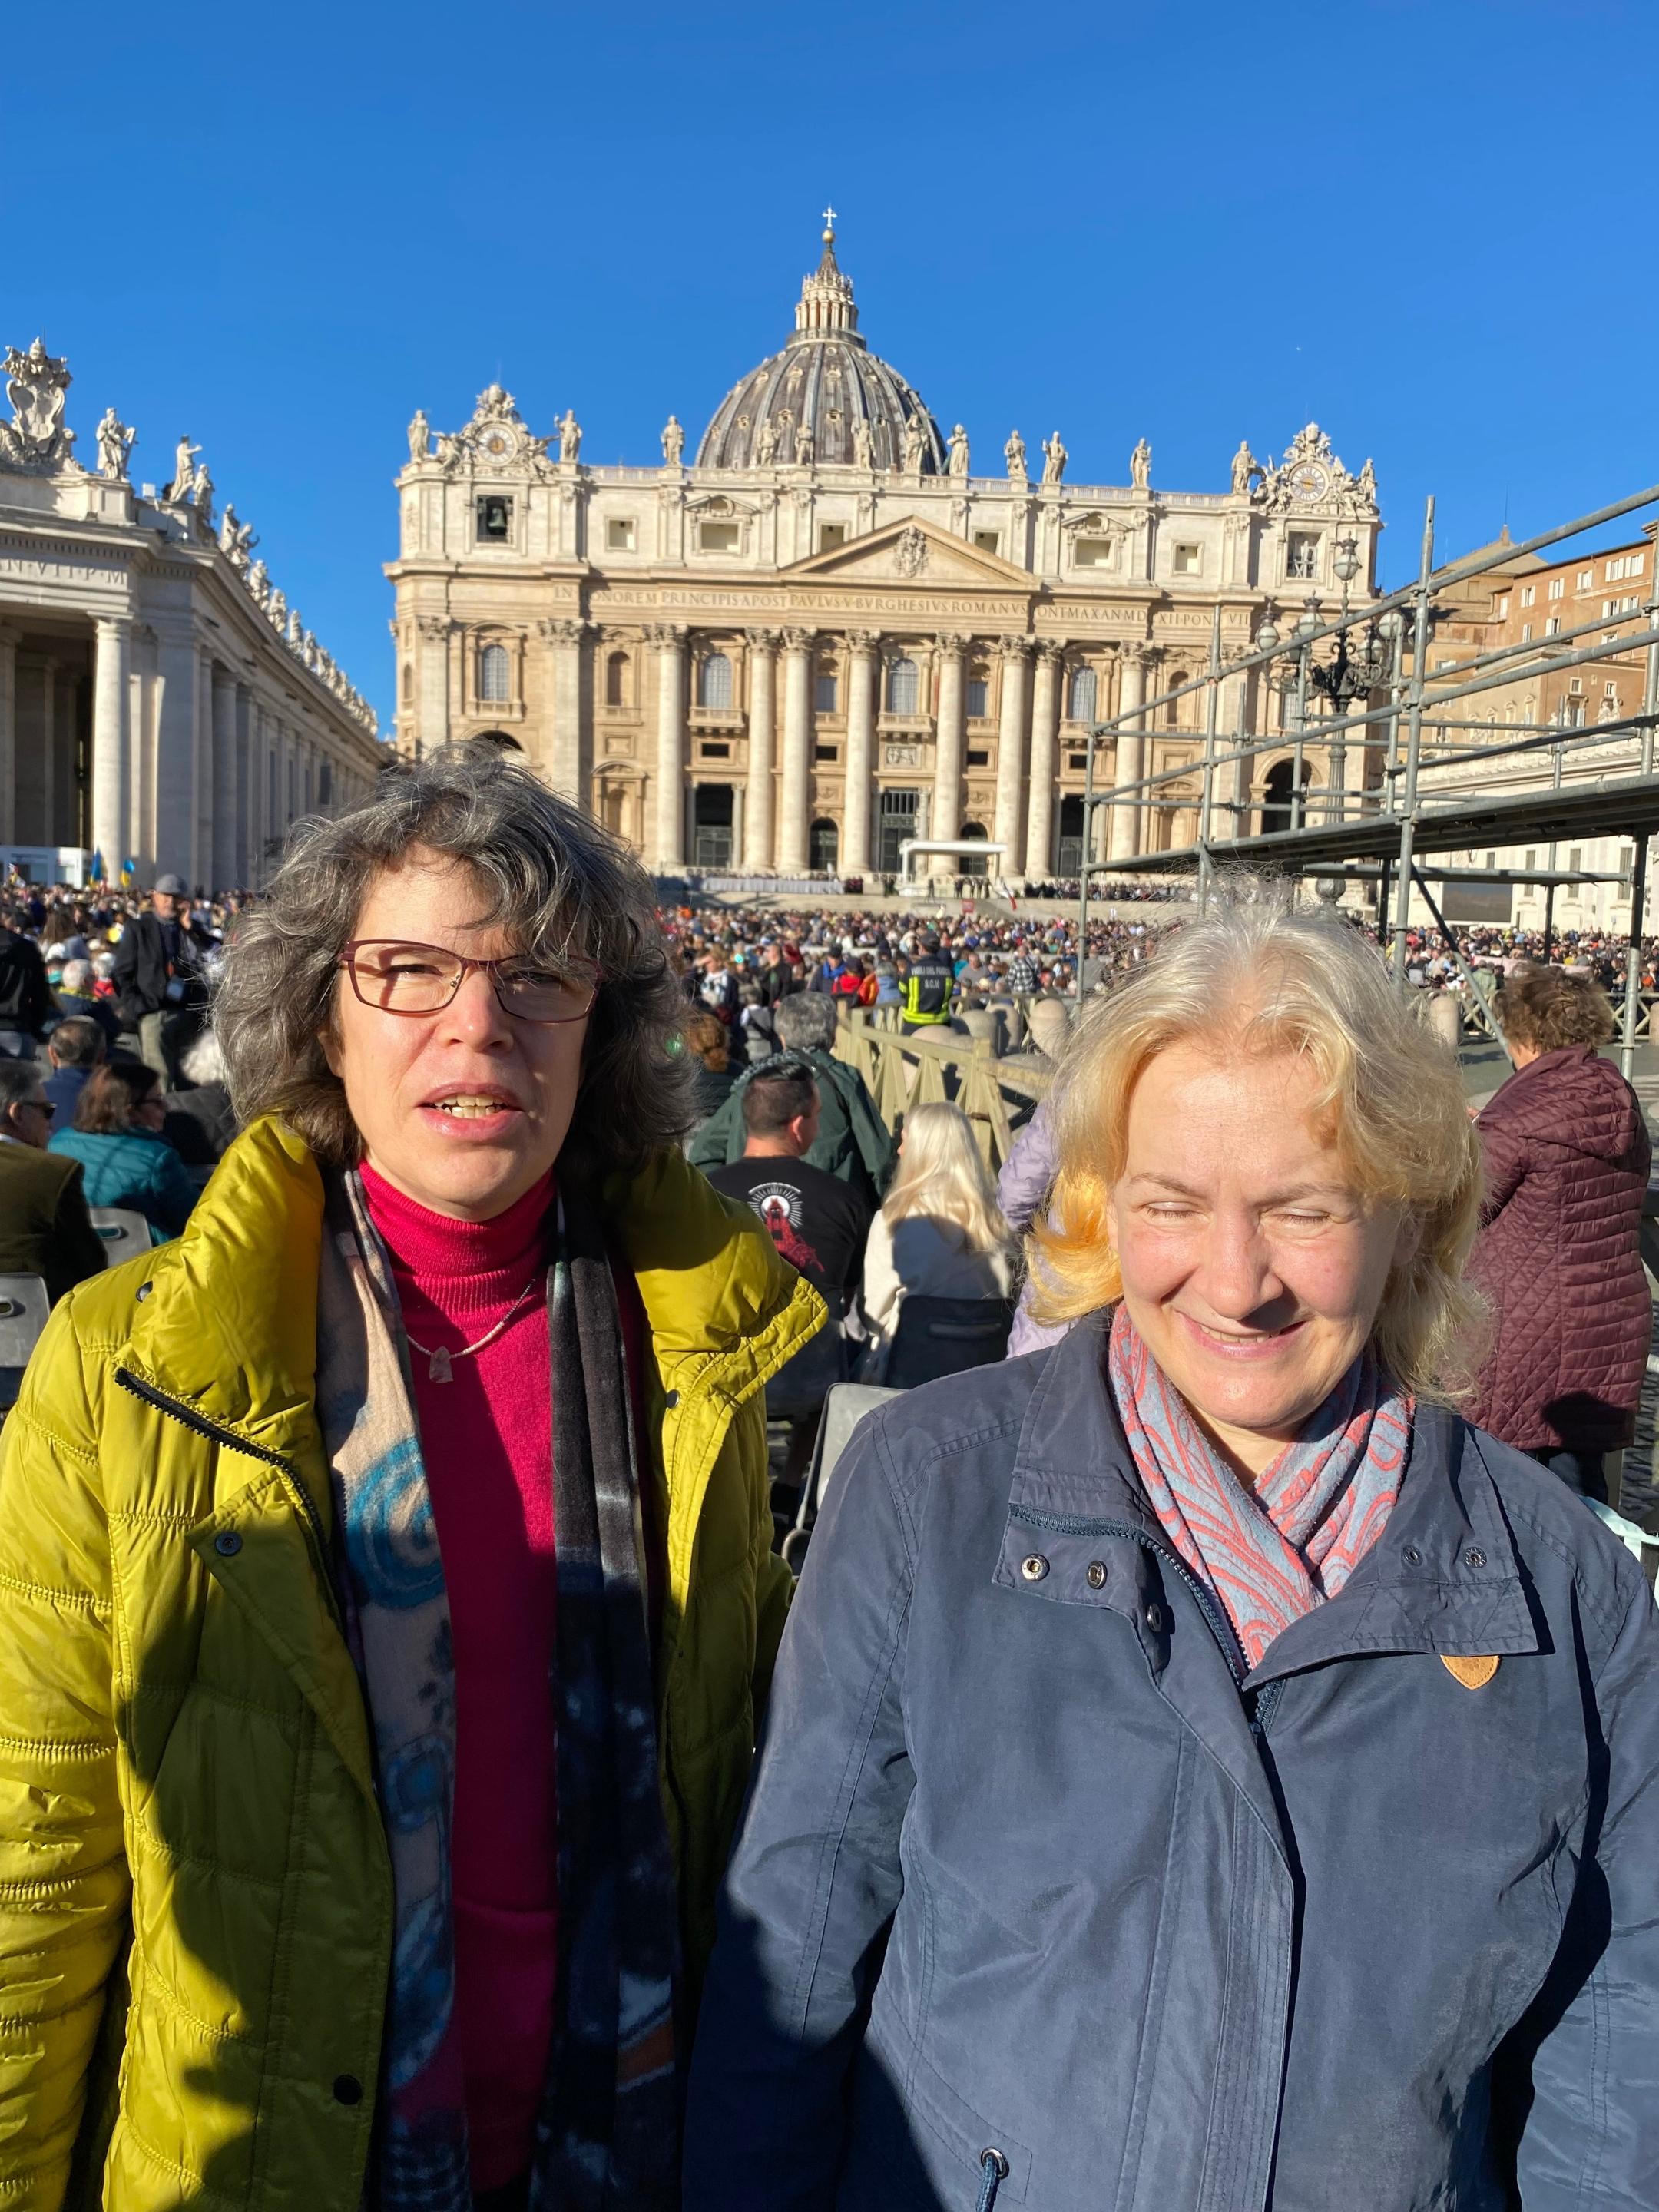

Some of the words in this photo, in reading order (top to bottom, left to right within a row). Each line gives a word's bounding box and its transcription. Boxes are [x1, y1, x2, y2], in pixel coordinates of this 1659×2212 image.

[583, 590, 657, 604] ONOREM
[661, 591, 737, 605] PRINCIPIS
[740, 594, 787, 608] APOST
[790, 594, 840, 608] PAVLVS
[856, 597, 948, 612] BVRGHESIVS
[952, 601, 1027, 614] ROMANVS
[1183, 614, 1218, 626] PON
